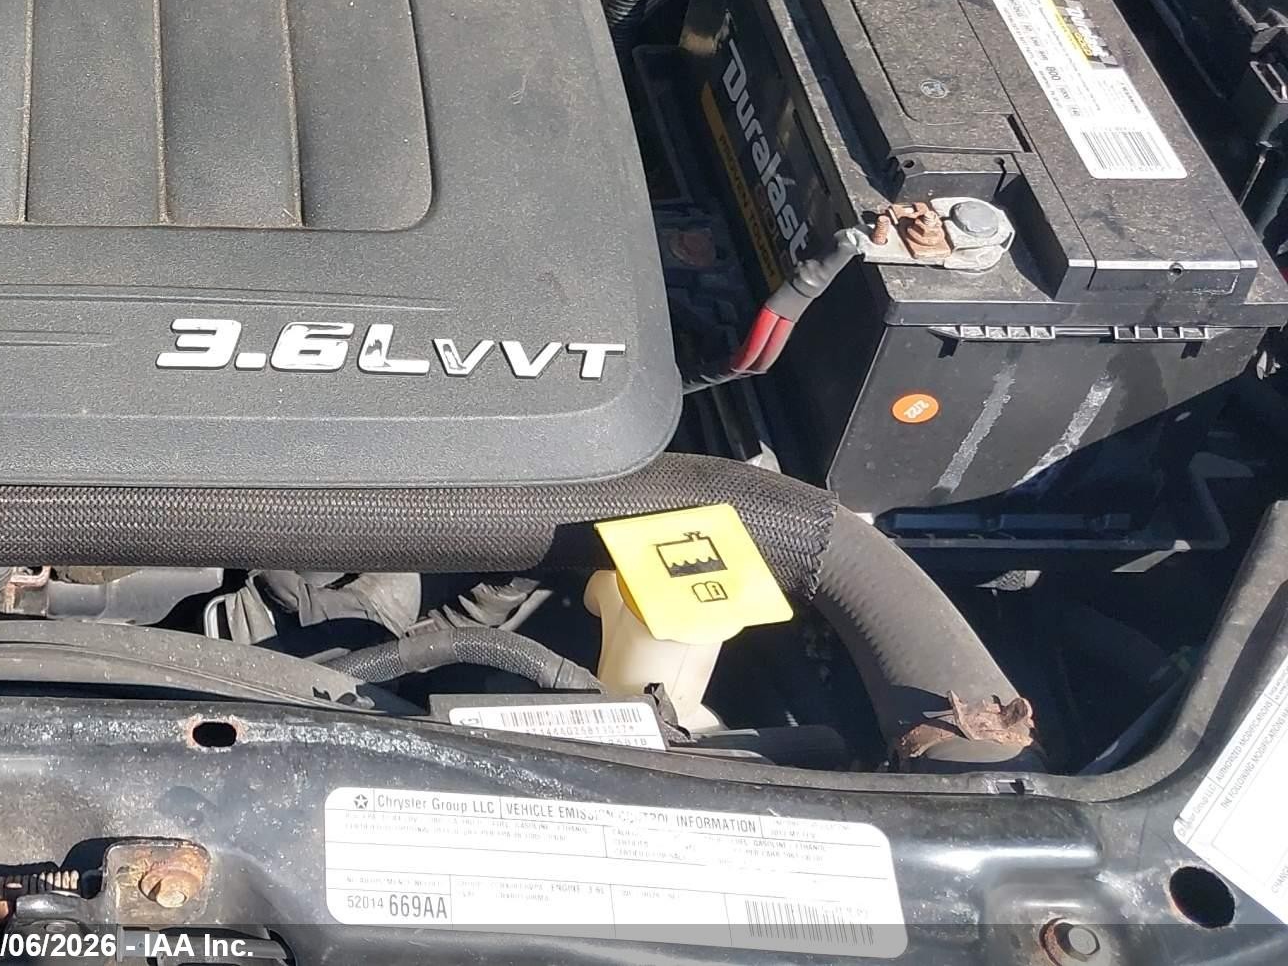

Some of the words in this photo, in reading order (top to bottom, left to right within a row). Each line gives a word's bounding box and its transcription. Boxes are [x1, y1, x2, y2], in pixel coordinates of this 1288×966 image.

[721, 38, 810, 266] Duralast
[431, 337, 627, 380] VVT
[377, 793, 427, 812] Chrysler
[431, 797, 468, 814] Group
[472, 799, 495, 814] LLC
[505, 802, 554, 818] VEHICLE
[676, 815, 757, 833] INFORMATION
[346, 896, 384, 910] 52014
[389, 894, 448, 919] 669AA
